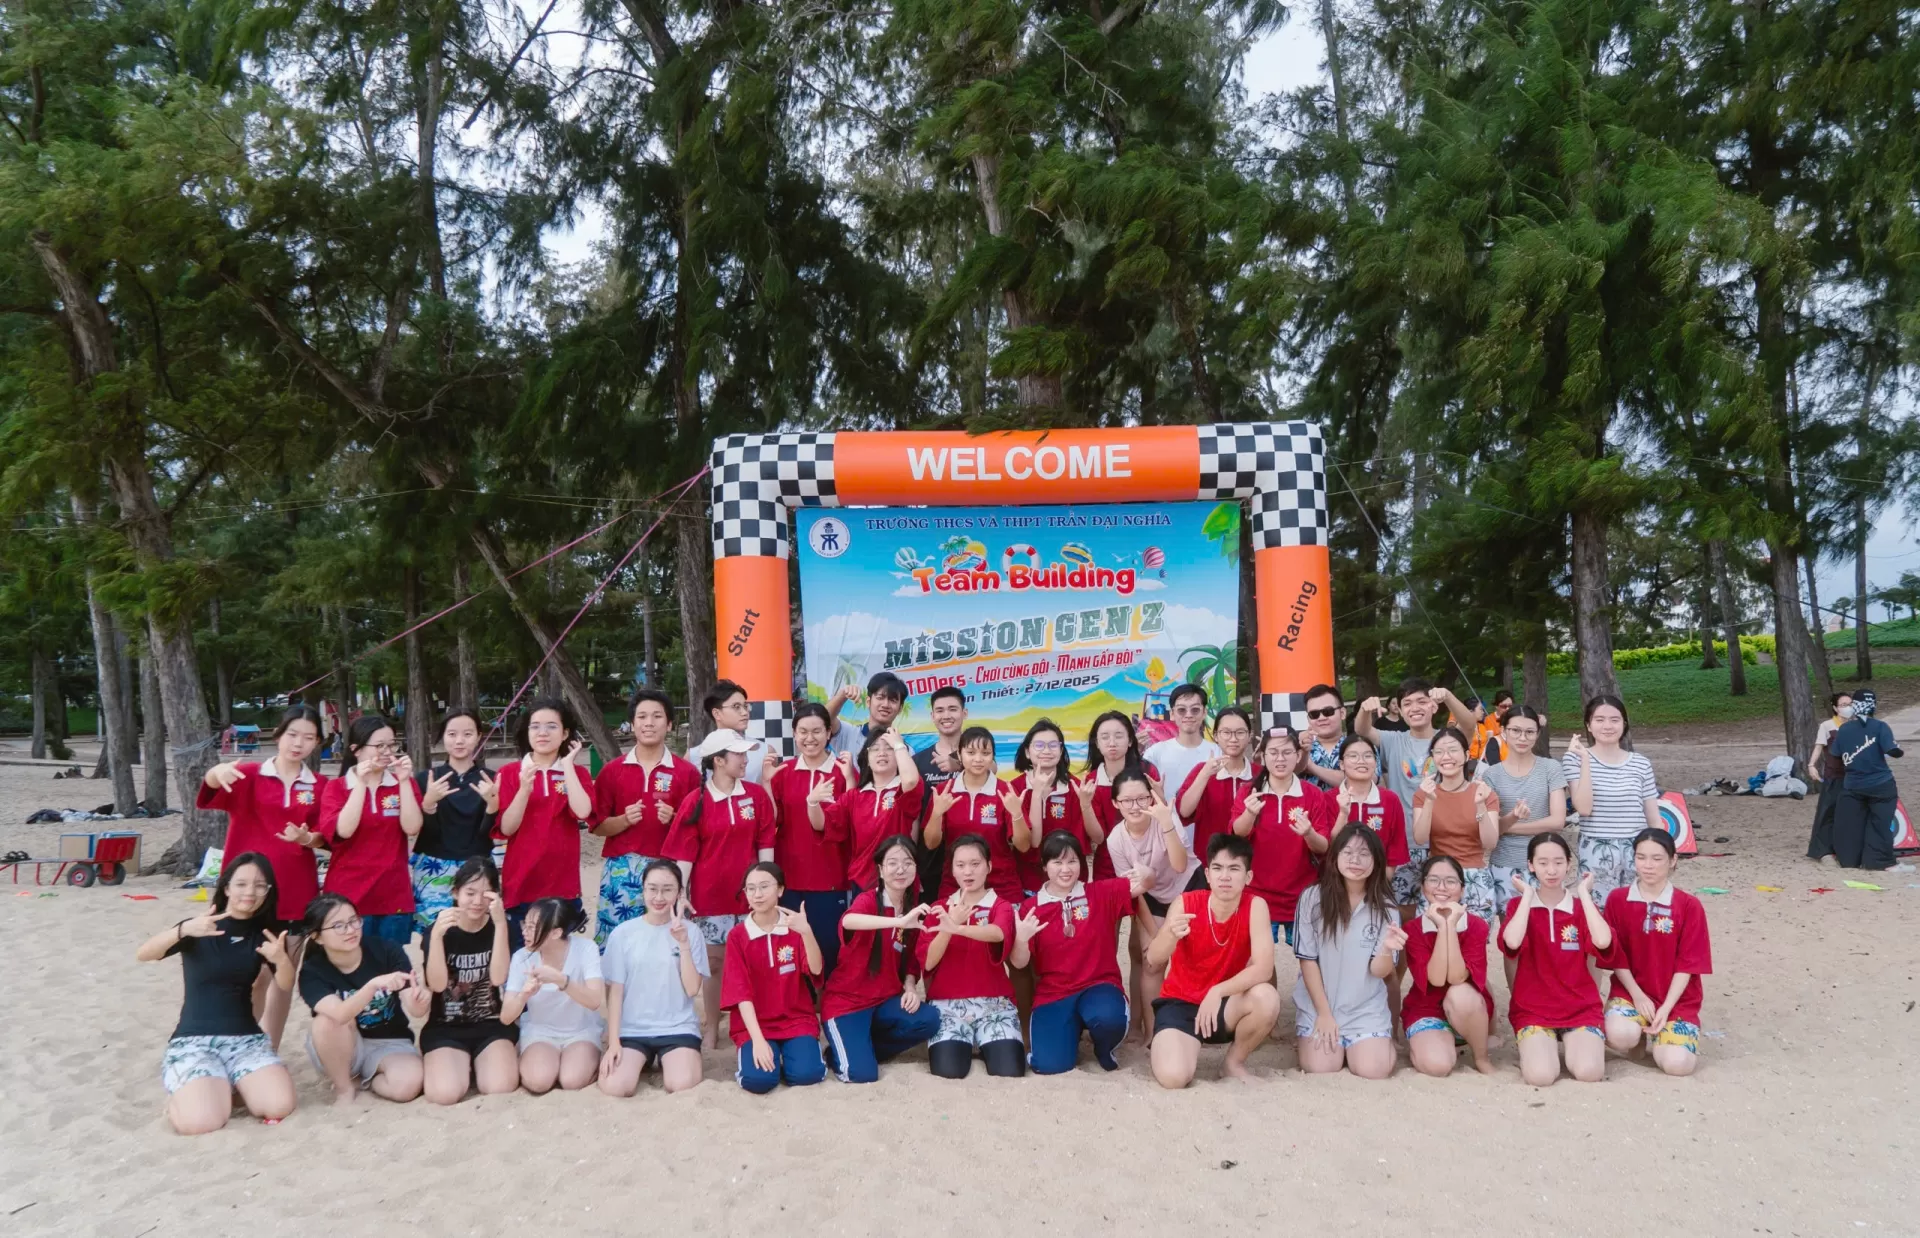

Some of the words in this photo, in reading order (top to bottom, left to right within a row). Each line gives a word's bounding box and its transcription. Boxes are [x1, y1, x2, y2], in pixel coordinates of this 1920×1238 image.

[906, 444, 1132, 481] WELCOME
[866, 515, 929, 530] TRƯỜNG
[934, 517, 974, 529] THCS
[978, 514, 999, 528] VÀ
[1003, 516, 1042, 528] THPT
[1047, 511, 1087, 527] TRẦN
[1091, 514, 1118, 529] ĐẠI
[1123, 512, 1171, 526] NGHĨA
[912, 567, 1000, 593] Team
[1009, 561, 1136, 594] Building
[727, 608, 760, 657] Start
[1054, 604, 1132, 643] GEN
[1140, 602, 1166, 633] Z
[1277, 580, 1318, 652] Racing
[981, 684, 1020, 701] Thiết:
[1025, 674, 1100, 694] 27/12/2025
